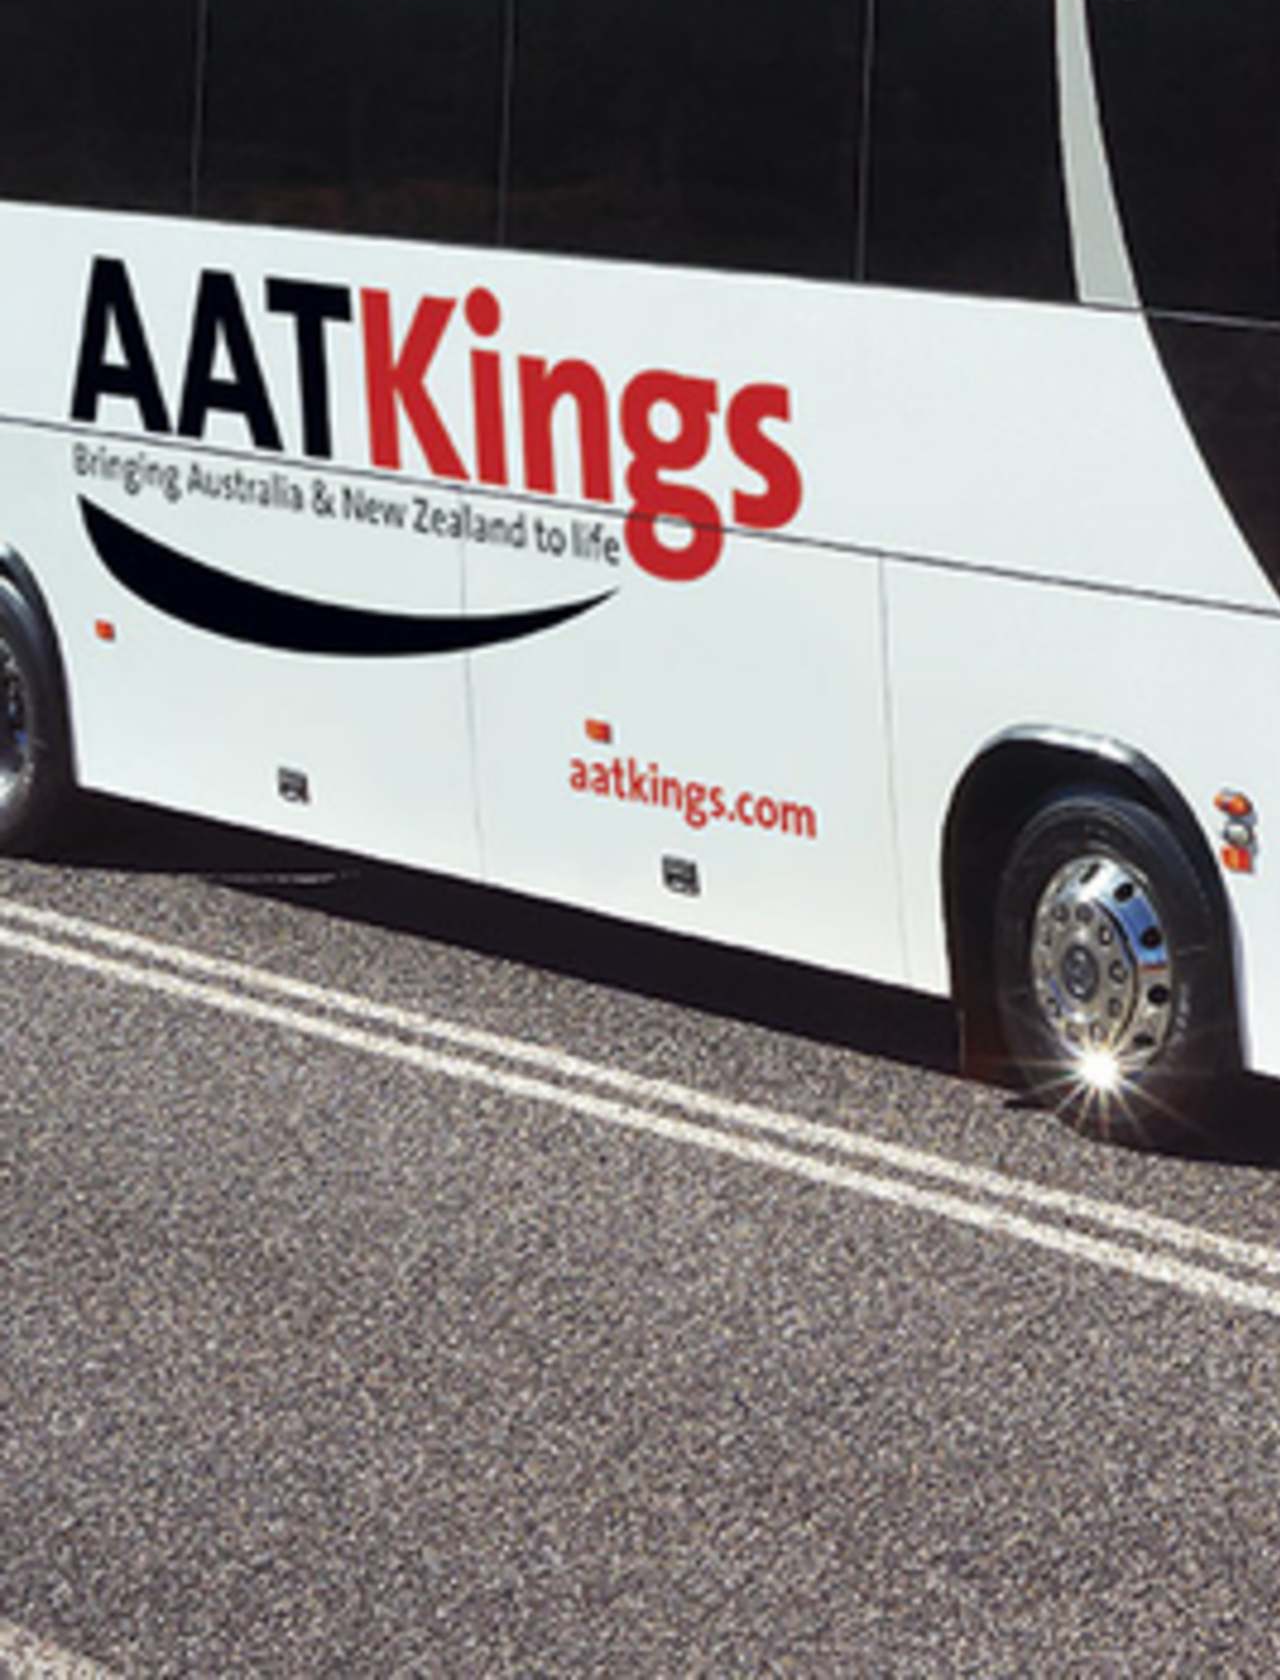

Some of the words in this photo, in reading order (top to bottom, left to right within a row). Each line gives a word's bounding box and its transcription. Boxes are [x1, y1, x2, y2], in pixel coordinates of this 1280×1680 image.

[70, 254, 802, 583] AATKings
[73, 441, 182, 504] Bringing
[186, 462, 304, 513] Australia
[311, 478, 336, 519] &
[341, 487, 408, 529] New
[412, 495, 528, 549] Zealand
[533, 517, 568, 557] to
[570, 519, 622, 567] life
[568, 756, 819, 840] aatkings.com
